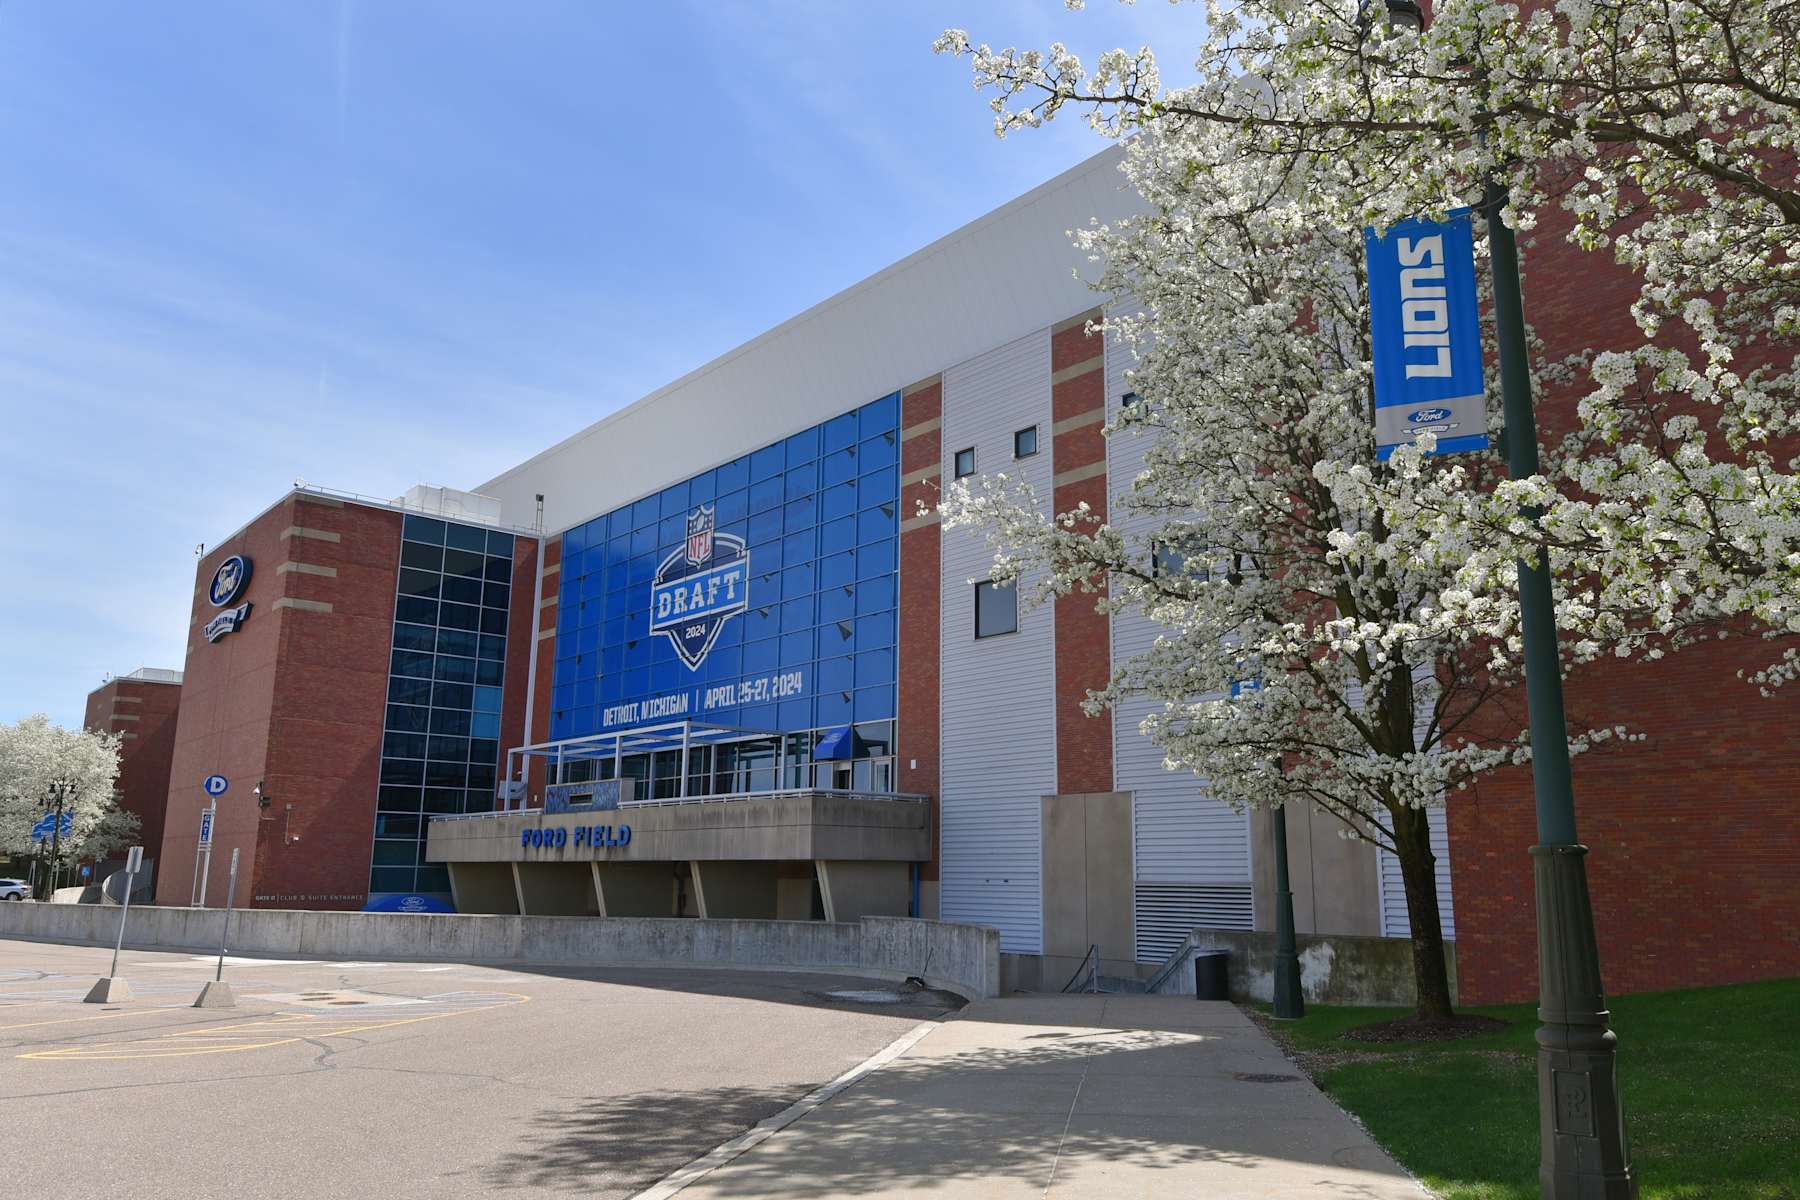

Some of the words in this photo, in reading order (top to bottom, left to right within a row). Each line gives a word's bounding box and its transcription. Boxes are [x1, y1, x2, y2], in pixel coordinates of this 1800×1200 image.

[1415, 408, 1444, 422] Ford
[688, 531, 711, 559] NFL
[214, 563, 239, 600] Ford
[657, 570, 740, 618] DRAFT
[685, 623, 706, 639] 2024
[603, 703, 640, 727] DETROIT,
[641, 693, 689, 719] MICHIGAN
[704, 684, 736, 709] APRIL
[738, 679, 769, 703] 25-27,
[772, 671, 802, 698] 2024
[210, 776, 226, 793] D
[202, 815, 211, 841] GATE
[522, 827, 567, 848] FORD
[574, 825, 632, 848] FIELD
